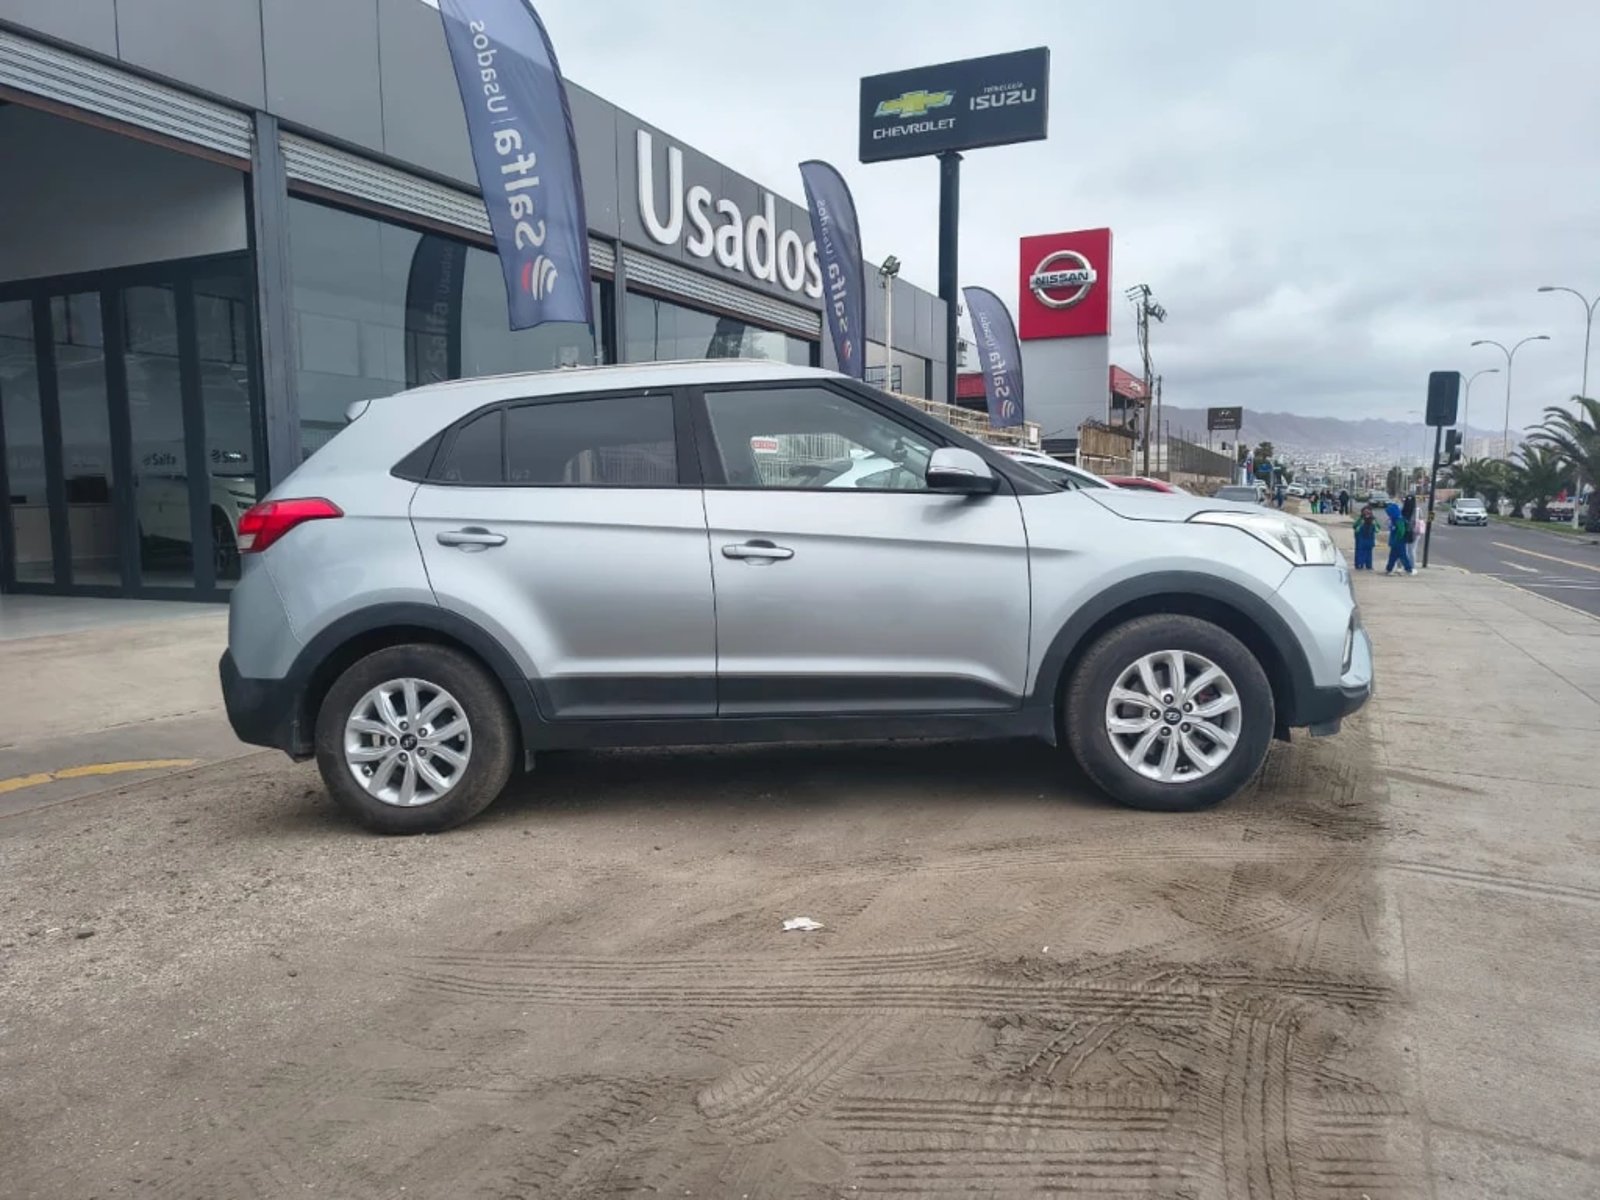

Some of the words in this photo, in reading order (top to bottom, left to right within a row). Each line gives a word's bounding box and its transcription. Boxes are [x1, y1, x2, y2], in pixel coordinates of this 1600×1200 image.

[969, 88, 1037, 111] ISUZU
[872, 118, 956, 140] CHEVROLET
[637, 129, 823, 298] Usados
[1034, 271, 1090, 285] NISSAN
[425, 301, 449, 363] Salfa
